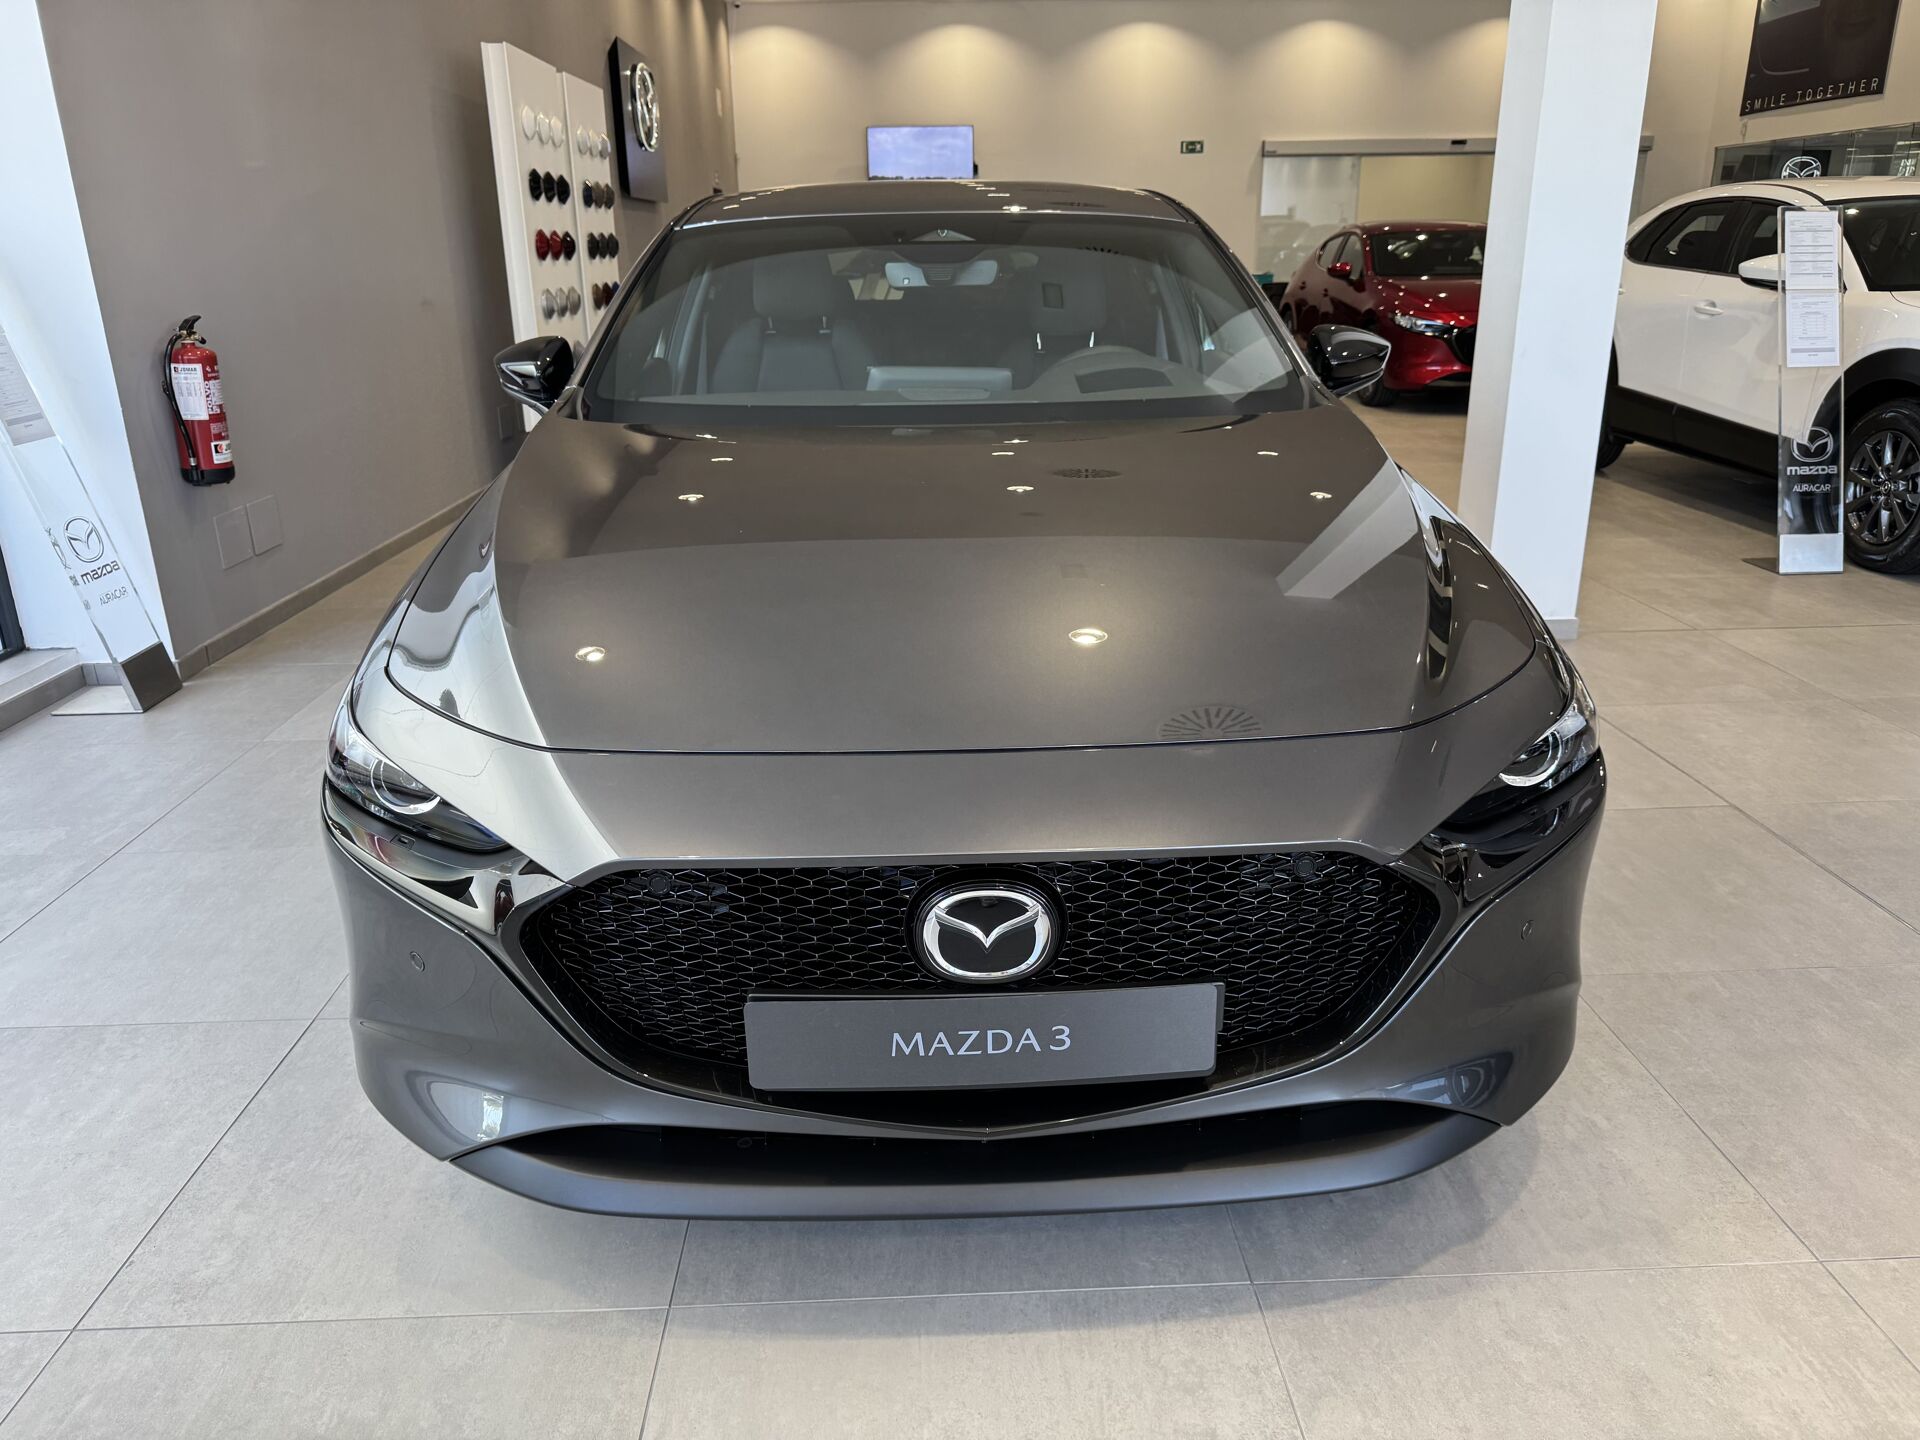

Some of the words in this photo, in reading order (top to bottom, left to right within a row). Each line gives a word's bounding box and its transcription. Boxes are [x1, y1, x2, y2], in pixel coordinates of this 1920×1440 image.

[1745, 93, 1787, 112] SMILE
[1796, 77, 1880, 102] TOGETHER
[1786, 465, 1838, 476] mazda
[1792, 483, 1832, 492] AURACAR
[80, 560, 121, 585] mazda
[99, 586, 128, 605] AURACAR
[891, 1027, 1042, 1057] MAZDA
[1049, 1025, 1072, 1051] 3
